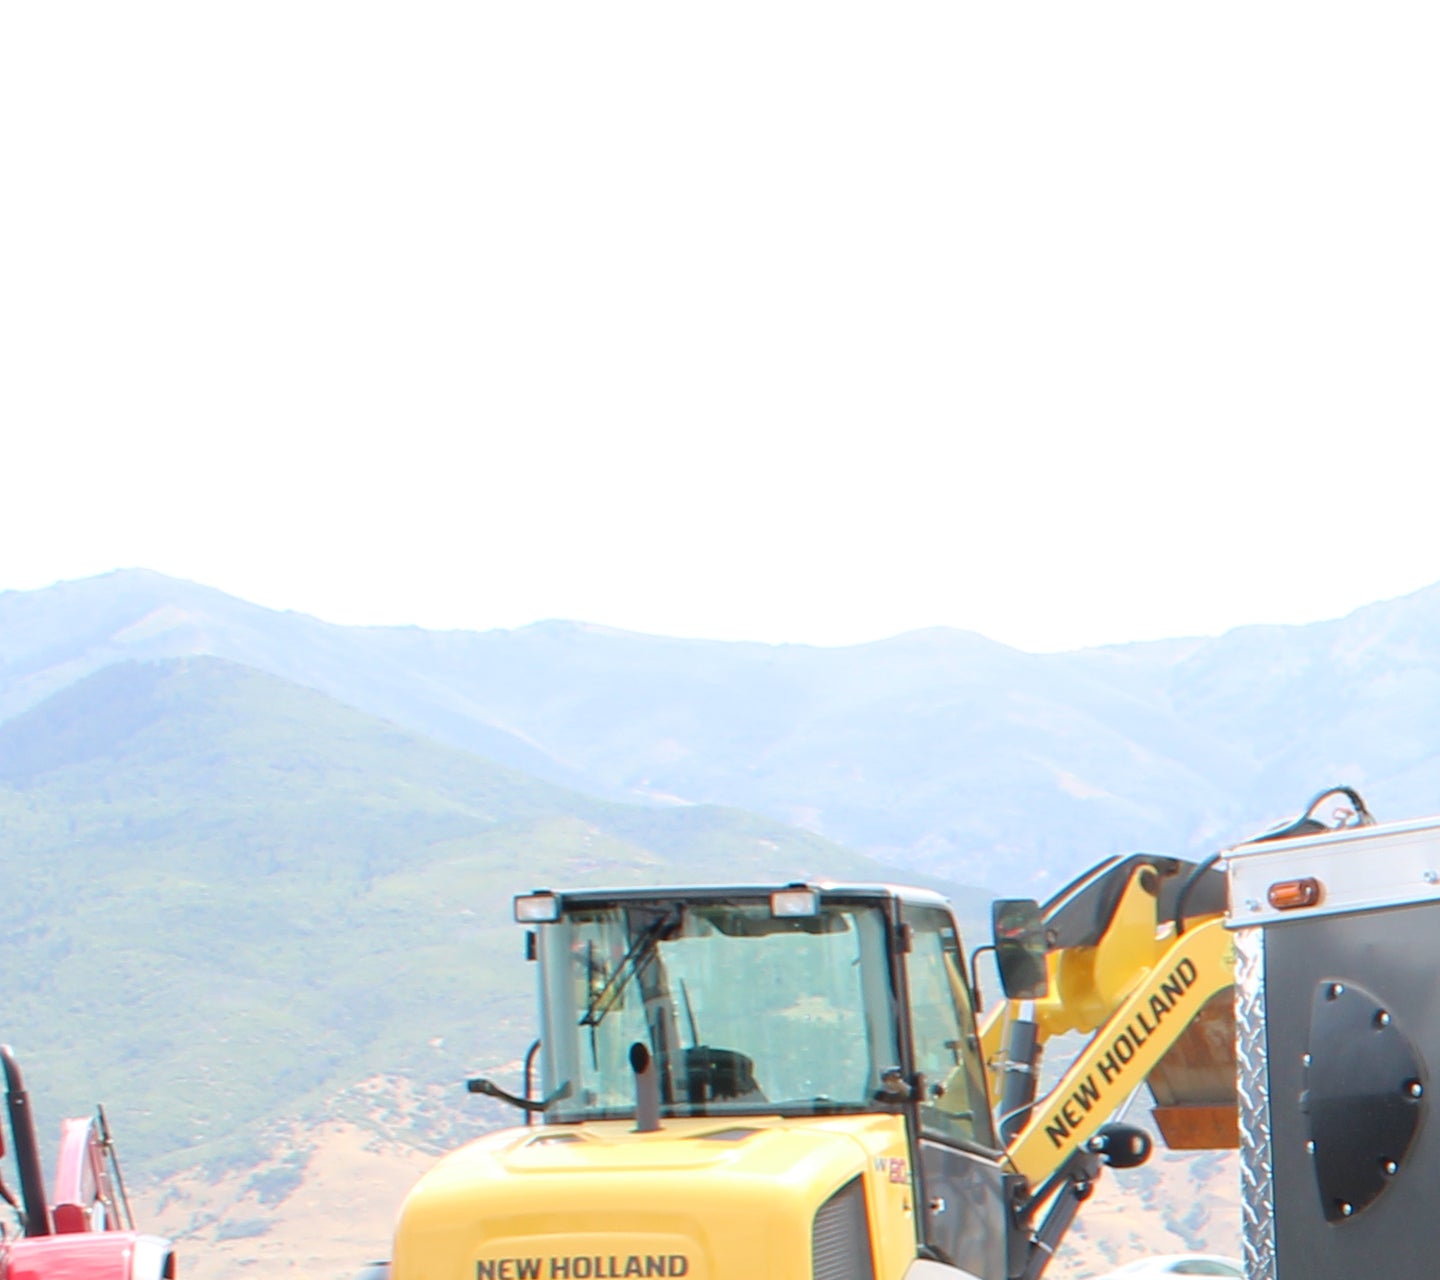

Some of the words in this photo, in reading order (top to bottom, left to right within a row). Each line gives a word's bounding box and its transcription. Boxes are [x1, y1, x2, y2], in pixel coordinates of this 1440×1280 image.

[1044, 1074, 1100, 1149] NEW
[1096, 957, 1197, 1085] HOLLAND
[550, 1255, 689, 1280] HOLLAND
